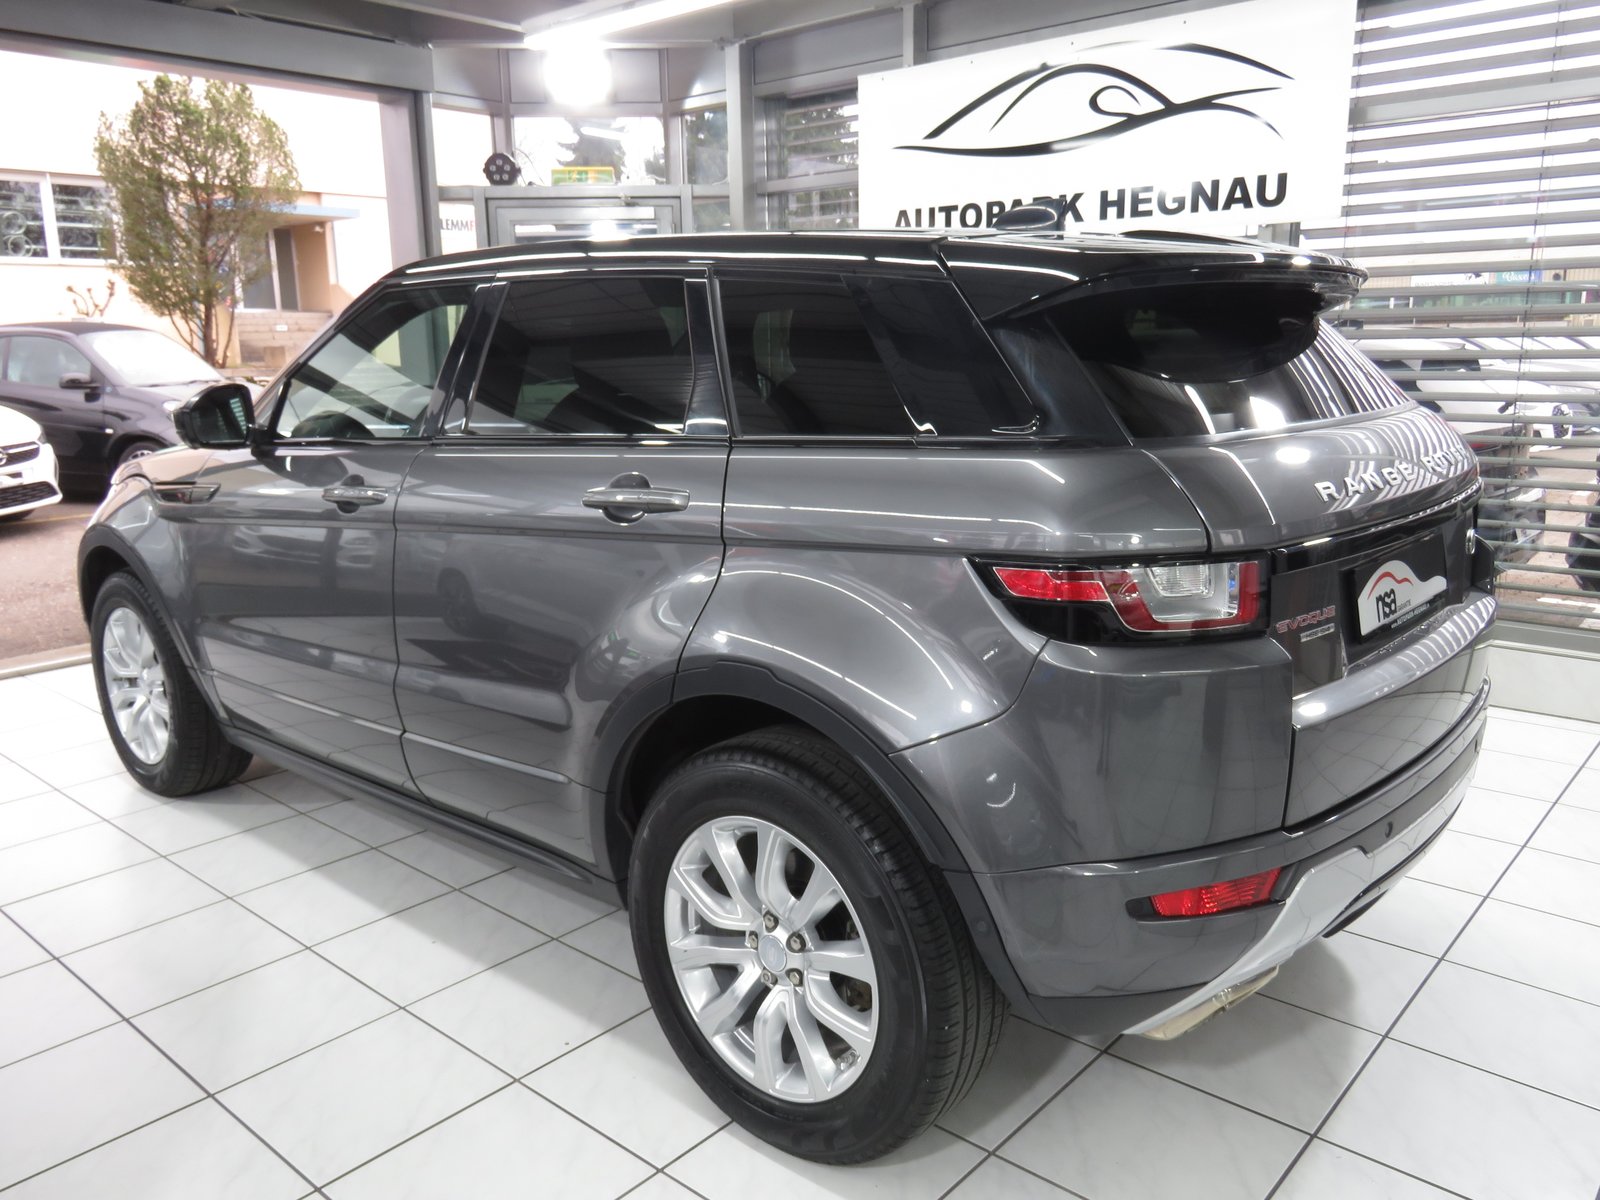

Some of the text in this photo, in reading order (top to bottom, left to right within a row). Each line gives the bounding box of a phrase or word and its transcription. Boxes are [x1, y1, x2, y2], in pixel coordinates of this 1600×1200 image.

[895, 172, 1288, 229] AUTOPK HEGNAU
[1314, 461, 1418, 502] RANGE
[1276, 605, 1336, 633] EVOQUE
[1376, 588, 1398, 623] nsa
